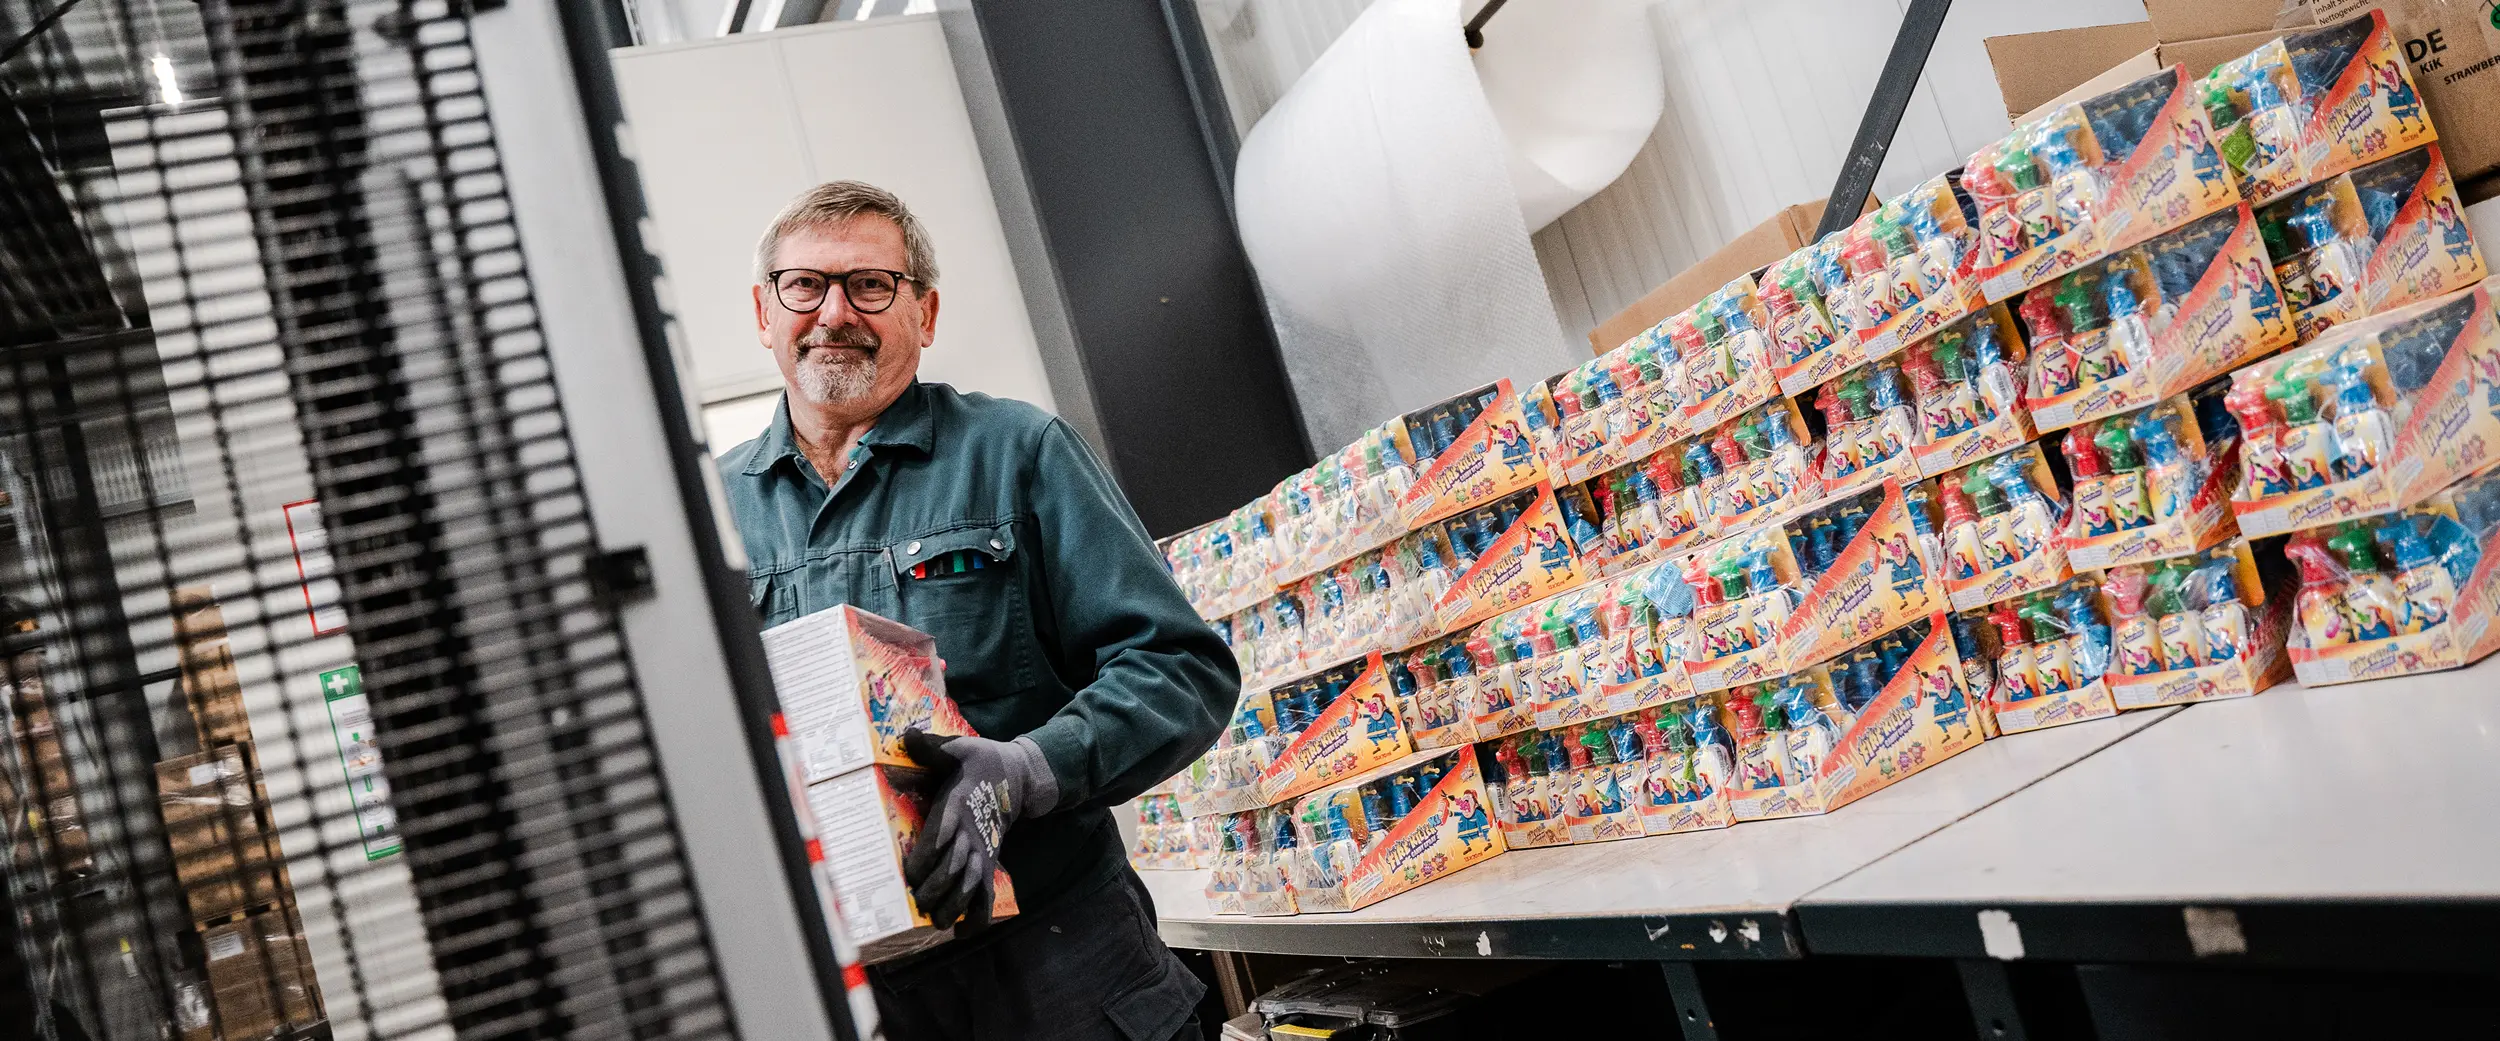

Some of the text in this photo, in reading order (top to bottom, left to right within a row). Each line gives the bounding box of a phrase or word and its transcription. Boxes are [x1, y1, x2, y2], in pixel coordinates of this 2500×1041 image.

[2404, 28, 2448, 63] DE
[1427, 814, 1442, 828] XL
[1386, 841, 1411, 873] FIRE
